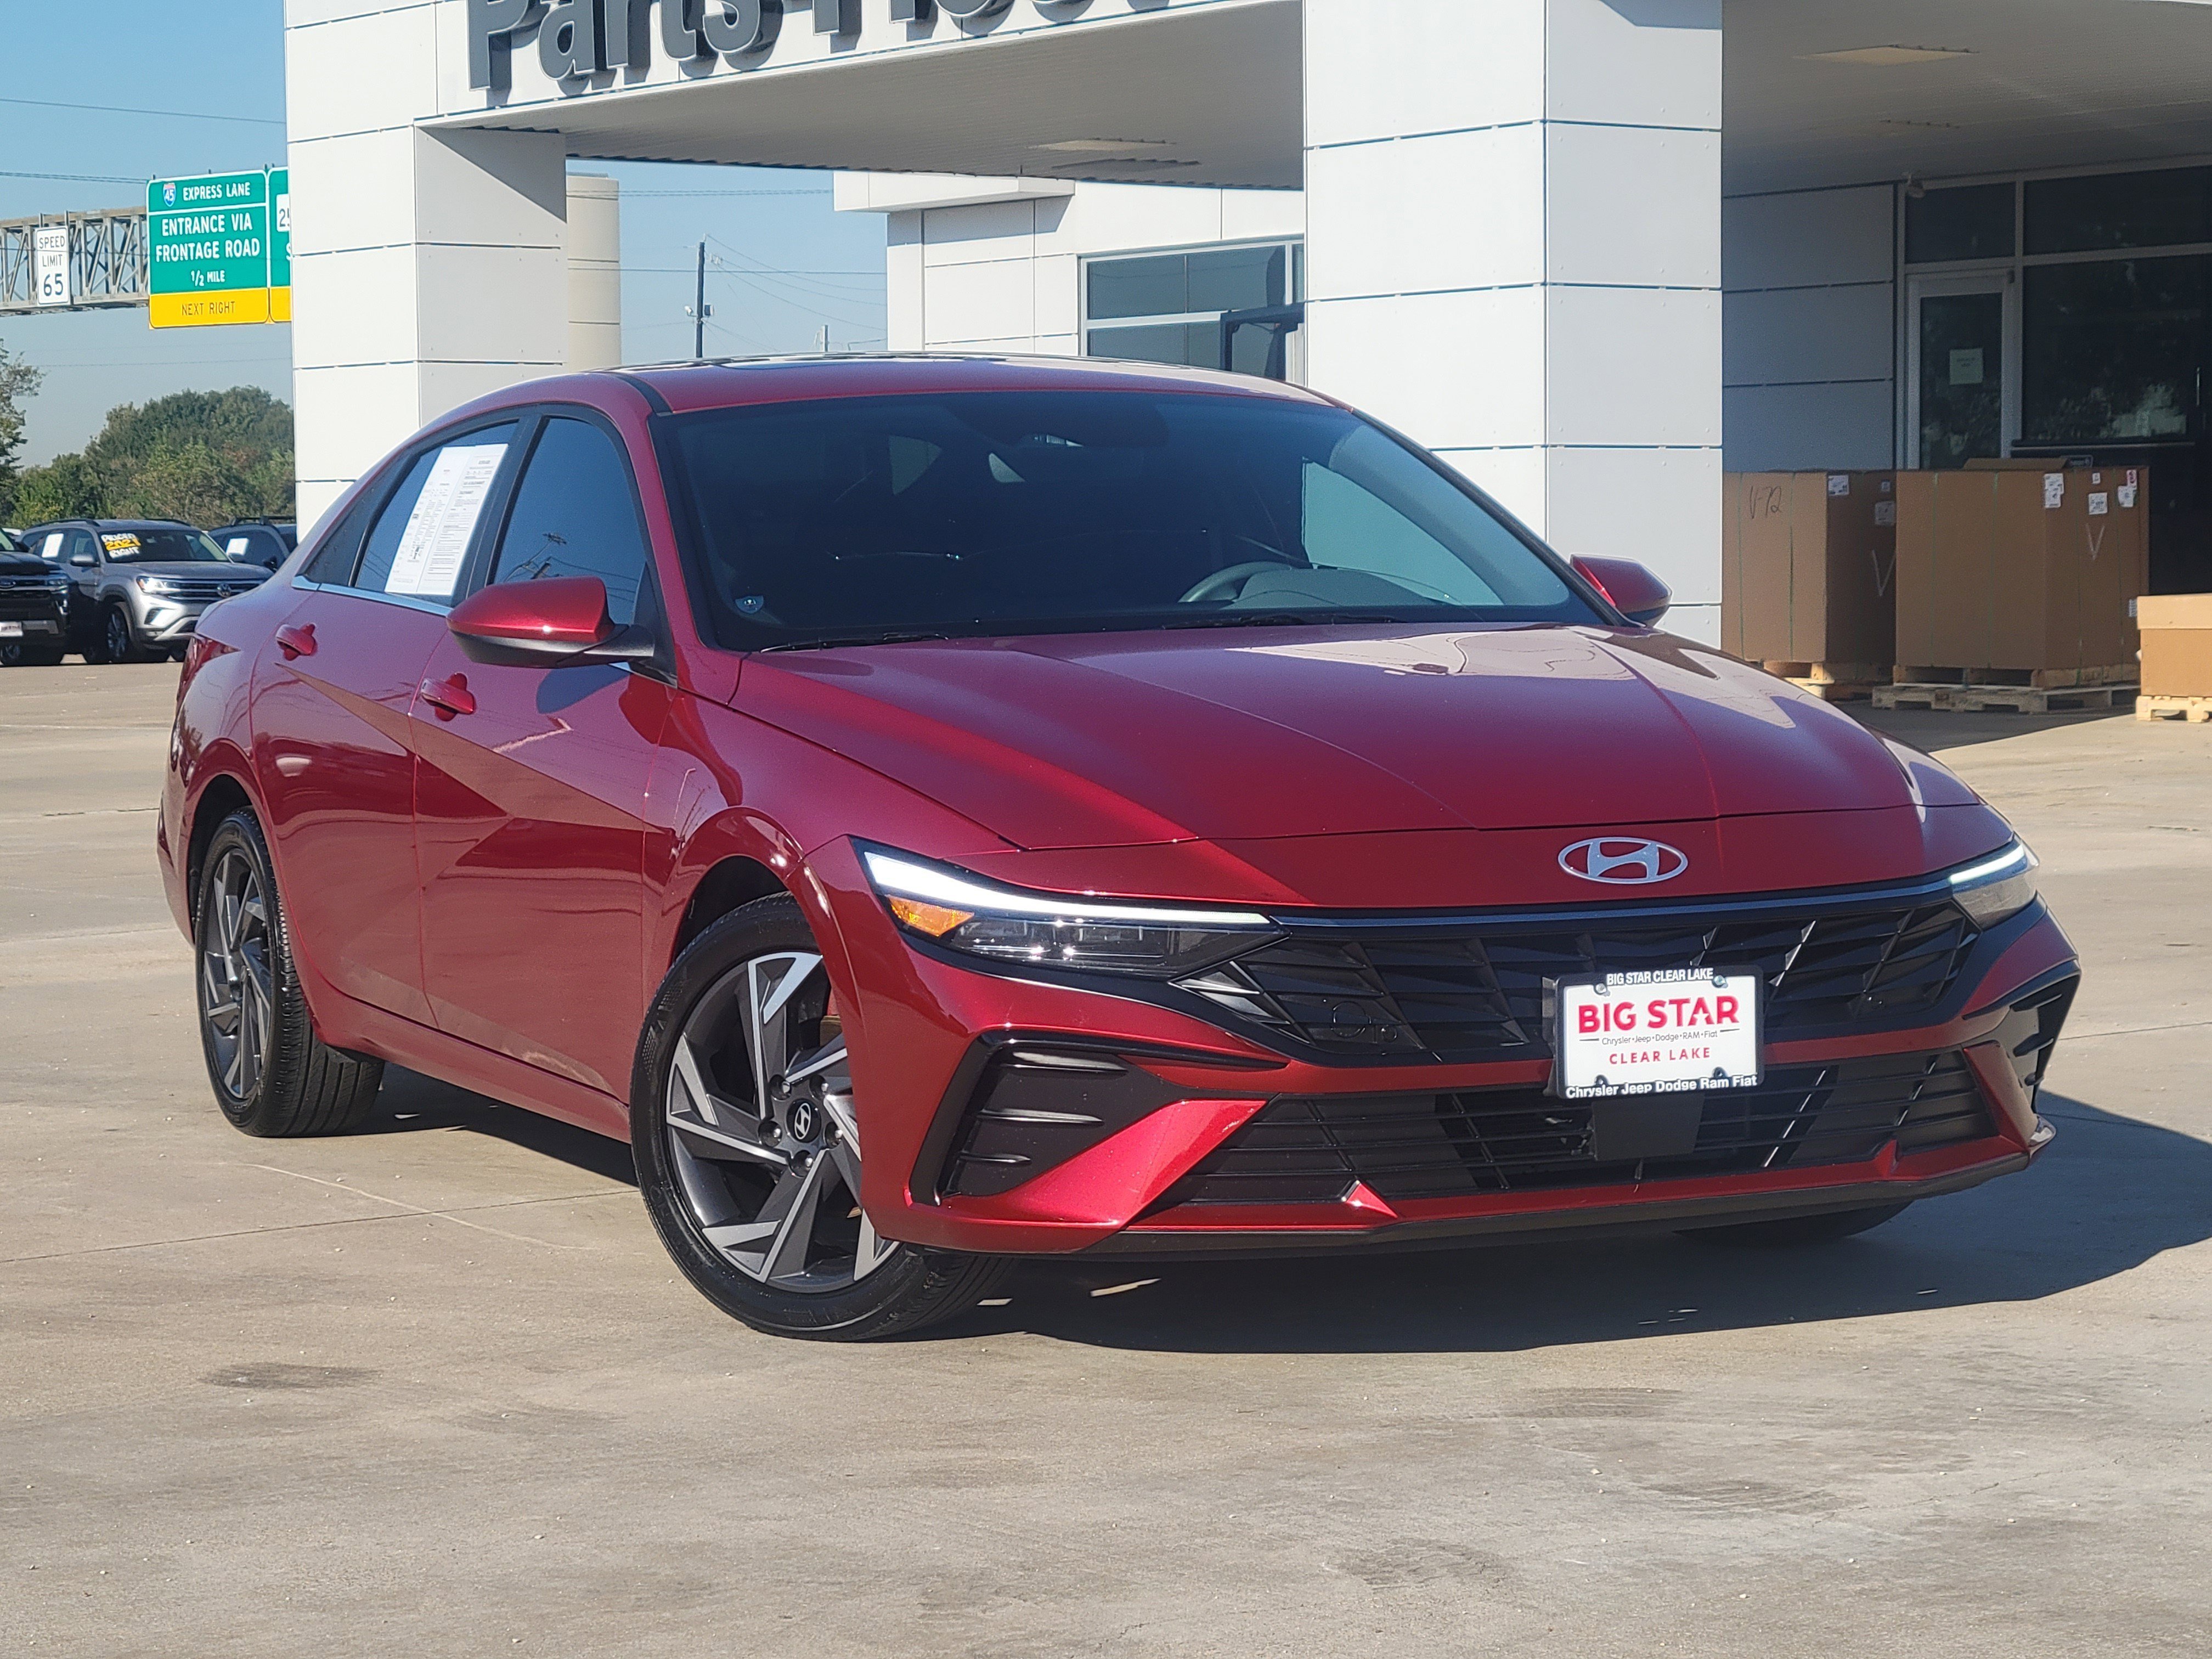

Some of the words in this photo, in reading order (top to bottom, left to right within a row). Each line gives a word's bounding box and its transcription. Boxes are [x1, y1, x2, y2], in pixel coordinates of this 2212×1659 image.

[165, 190, 175, 201] 45
[183, 184, 222, 201] EXPRESS
[226, 182, 251, 198] LANE
[162, 214, 225, 236] ENTRANCE
[231, 212, 253, 230] VIA
[38, 235, 65, 249] SPEED
[156, 241, 219, 262] FRONTAGE
[225, 238, 261, 258] ROAD
[42, 254, 62, 267] LIMIT
[43, 273, 64, 297] 65
[207, 270, 225, 283] MILE
[182, 302, 205, 315] NEXT
[209, 301, 235, 314] RIGHT
[1607, 973, 1624, 985] BIG
[1626, 970, 1651, 984] STAR
[1653, 969, 1686, 983] CLEAR
[1688, 967, 1714, 980] LAKE
[1578, 1001, 1637, 1034] BIG
[1647, 995, 1740, 1029] STAR
[1601, 1036, 1631, 1046] Chrysler
[1634, 1035, 1651, 1044] Jeep
[1656, 1033, 1679, 1042] Dodge
[1683, 1031, 1700, 1040] RAM
[1704, 1030, 1718, 1038] Fiat
[1610, 1051, 1661, 1064] CLEAR
[1669, 1047, 1711, 1060] LAKE
[1566, 1086, 1619, 1099] Chrysler
[1622, 1082, 1652, 1097] Jeep
[1656, 1080, 1697, 1093] Dodge
[1701, 1077, 1729, 1089] Ram
[1732, 1074, 1758, 1087] Fiat
